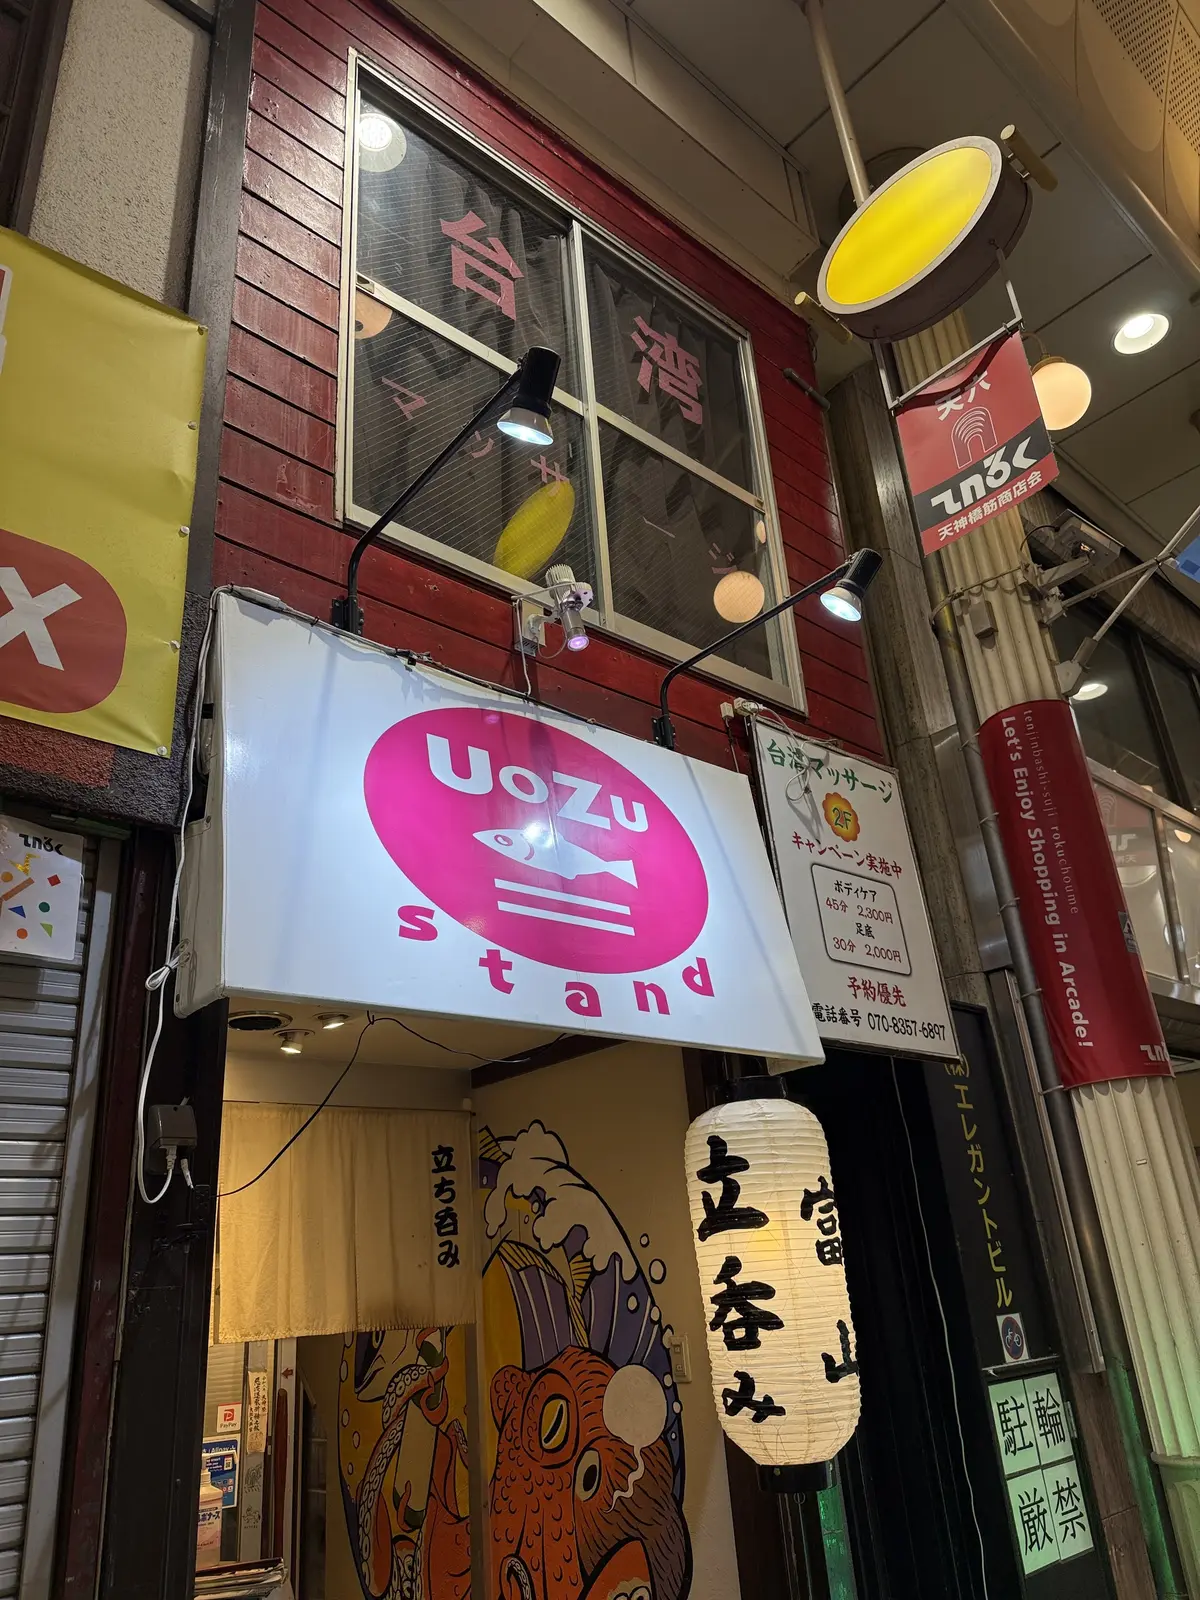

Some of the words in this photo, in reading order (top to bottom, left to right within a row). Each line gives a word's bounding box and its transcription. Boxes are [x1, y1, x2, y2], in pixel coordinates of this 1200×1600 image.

[937, 470, 1043, 542] 天神橋筋商店会
[1002, 716, 1023, 762] Let's
[767, 739, 892, 803] 台湾マッサージ
[1013, 767, 1036, 821] Enjoy
[832, 807, 852, 830] 2F
[1023, 709, 1058, 817] tenjinbashi-suji
[1051, 825, 1079, 914] rokuchoume
[792, 831, 902, 879] キャンペーン実施中
[1027, 828, 1061, 926] Shopping
[825, 897, 848, 913] 45分
[857, 905, 894, 924] 2,300円
[834, 880, 877, 902] ボディケア
[833, 937, 856, 953] 30分
[865, 944, 902, 963] 2,000円
[855, 922, 875, 939] 足底
[1052, 933, 1069, 953] in
[397, 905, 715, 1017] stand
[847, 976, 907, 1007] 予約優先
[1059, 961, 1094, 1047] Arcade!
[812, 1002, 862, 1027] 電話番号
[868, 1012, 946, 1041] 070-8357-6897
[431, 1145, 460, 1268] 立ち呑み
[696, 1135, 786, 1423] 立呑み
[800, 1175, 859, 1383] 富山
[996, 1388, 1066, 1456] 駐輪
[1018, 1477, 1087, 1556] 厳禁
